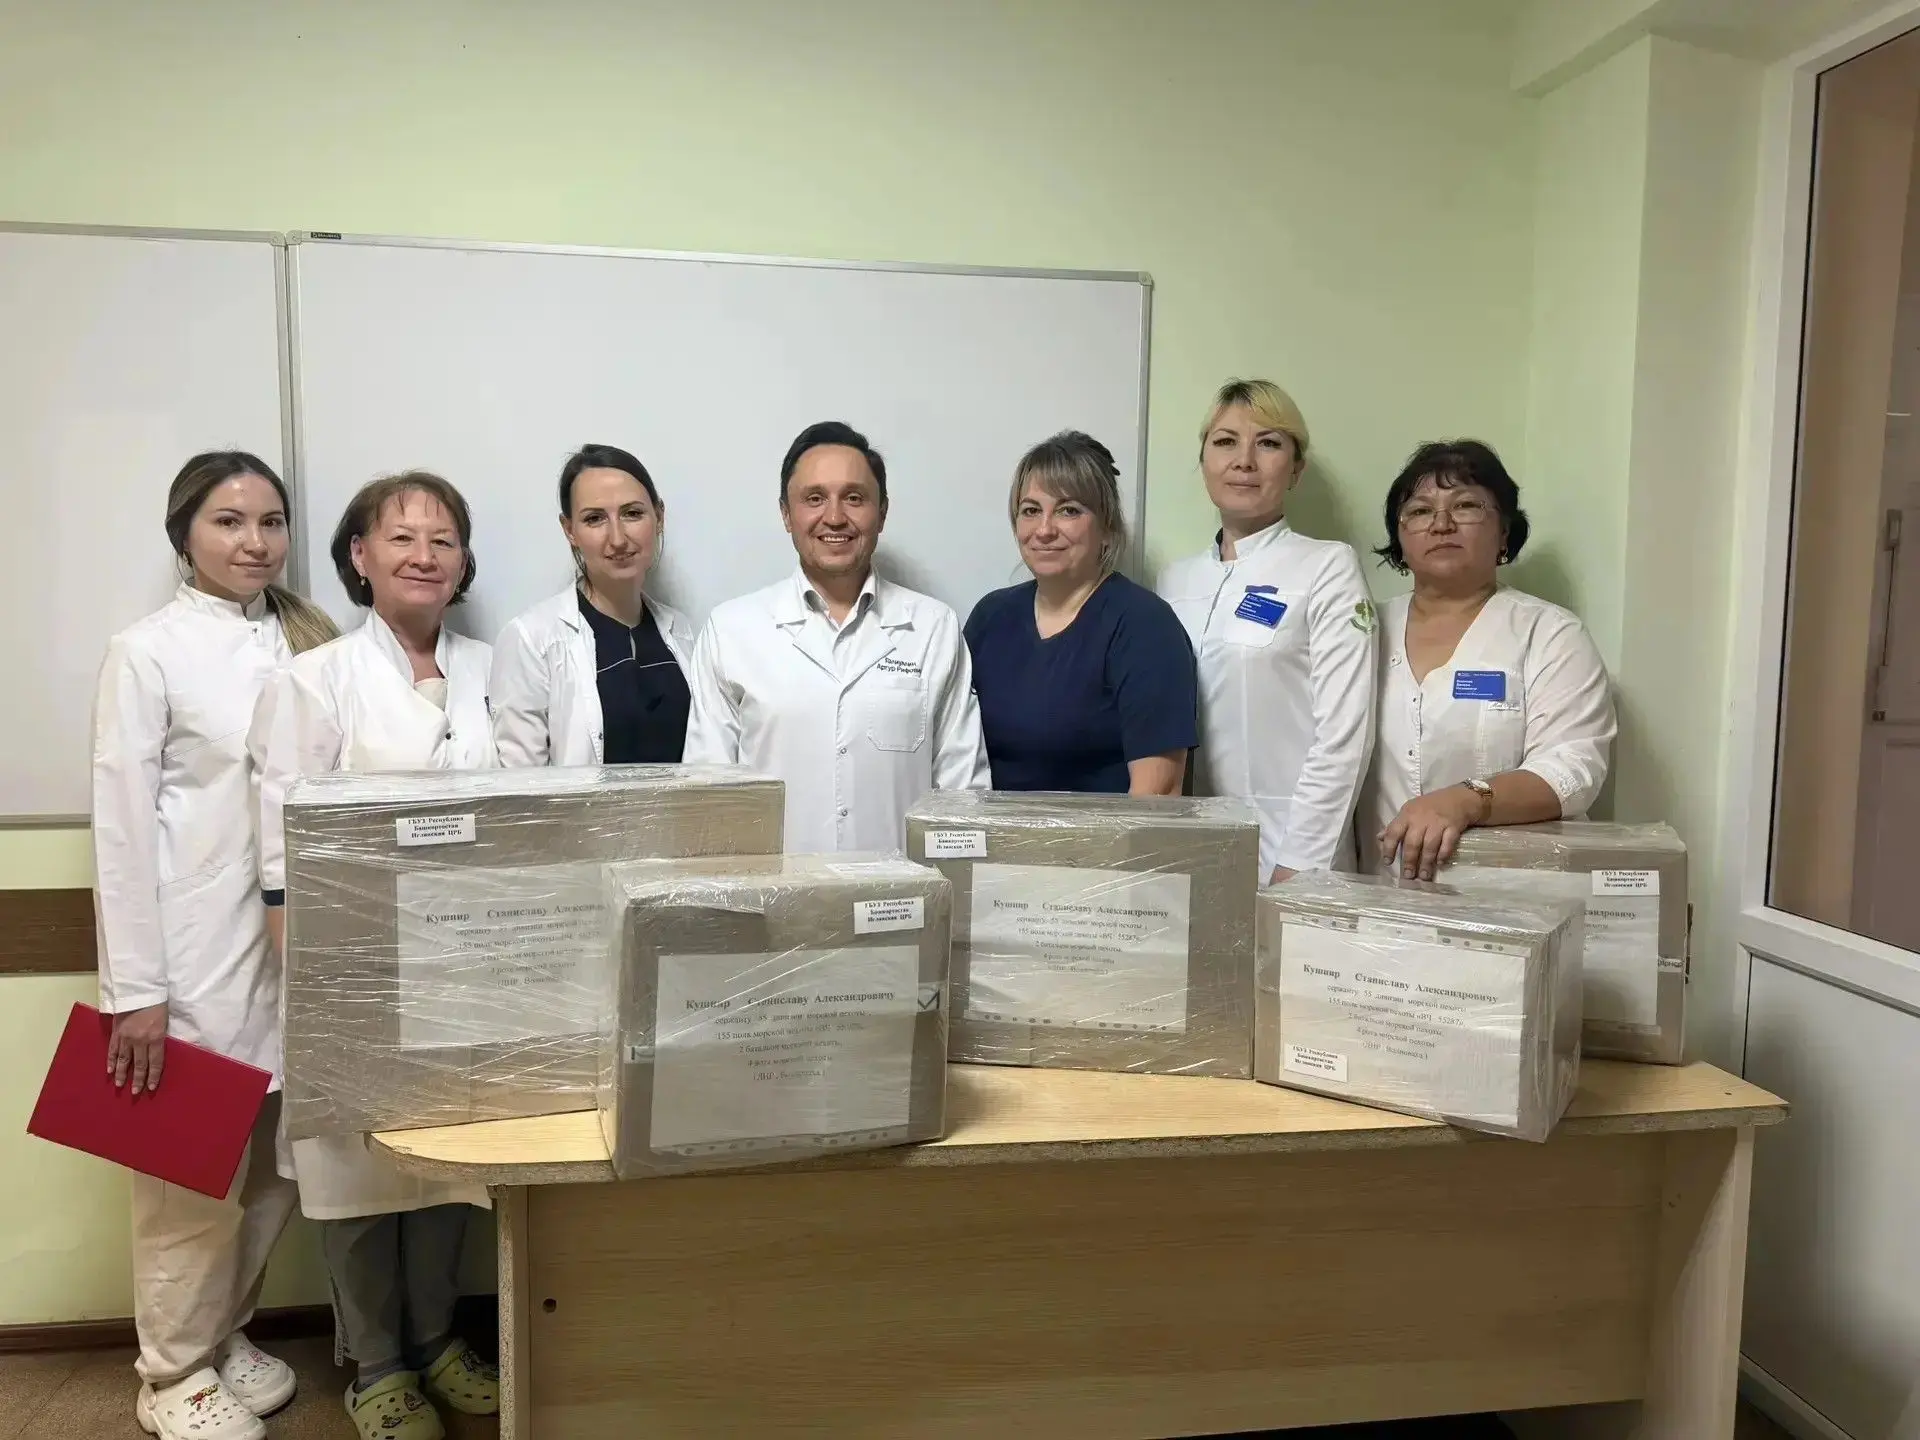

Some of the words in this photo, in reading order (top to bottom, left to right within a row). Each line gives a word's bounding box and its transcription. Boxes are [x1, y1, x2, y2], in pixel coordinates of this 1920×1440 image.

[426, 914, 470, 923] Кушнир
[487, 906, 547, 918] Станиславу
[993, 900, 1028, 911] Кушнир
[1097, 907, 1168, 919] Александровичу
[1304, 964, 1340, 979] Кушнир
[1355, 973, 1410, 991] Станиславу
[1415, 984, 1499, 1004] Александровичу
[815, 992, 895, 1003] Александровичу
[1329, 997, 1340, 1005] 155
[1408, 999, 1437, 1008] морской
